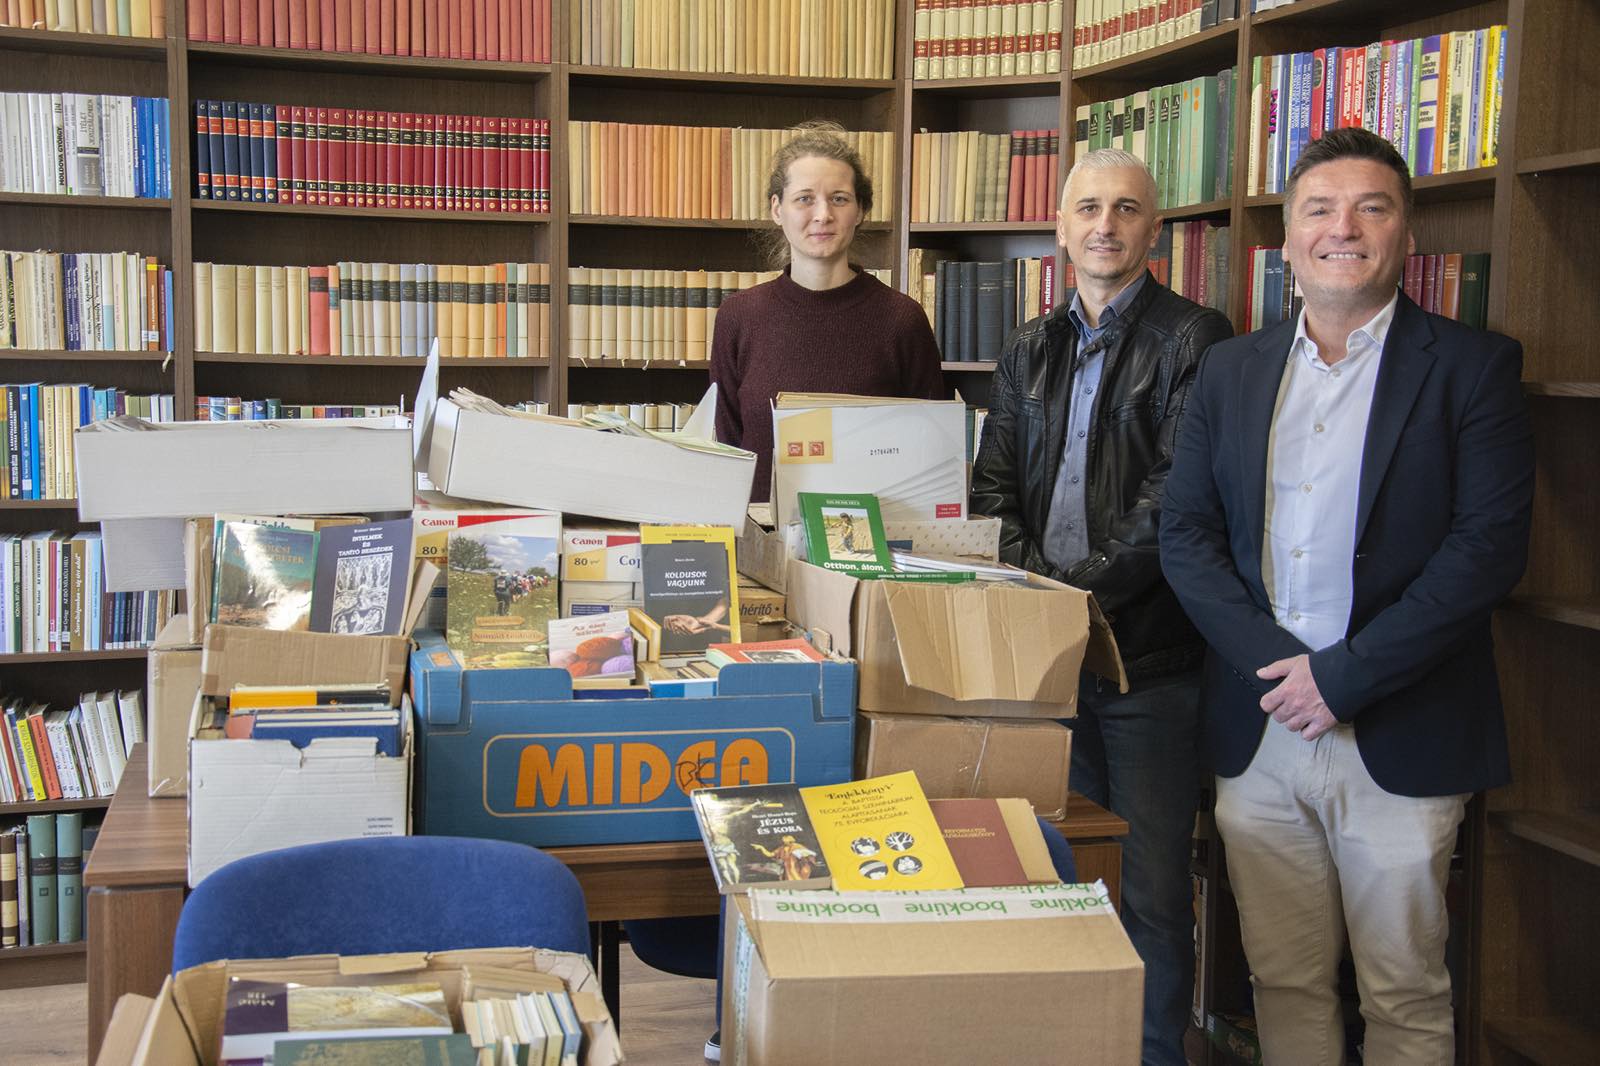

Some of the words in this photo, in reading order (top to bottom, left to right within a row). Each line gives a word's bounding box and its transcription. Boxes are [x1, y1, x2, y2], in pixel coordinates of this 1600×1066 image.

[1394, 107, 1402, 121] OF
[665, 570, 707, 579] KOLDUSOK
[666, 580, 706, 588] VAGYUNK
[740, 603, 772, 616] hérítő
[514, 738, 768, 807] MIDEA
[759, 818, 794, 827] JÉZUS
[773, 825, 803, 834] KORA
[776, 901, 880, 917] bookline
[904, 899, 1007, 916] bookline
[1031, 895, 1109, 912] ookline
